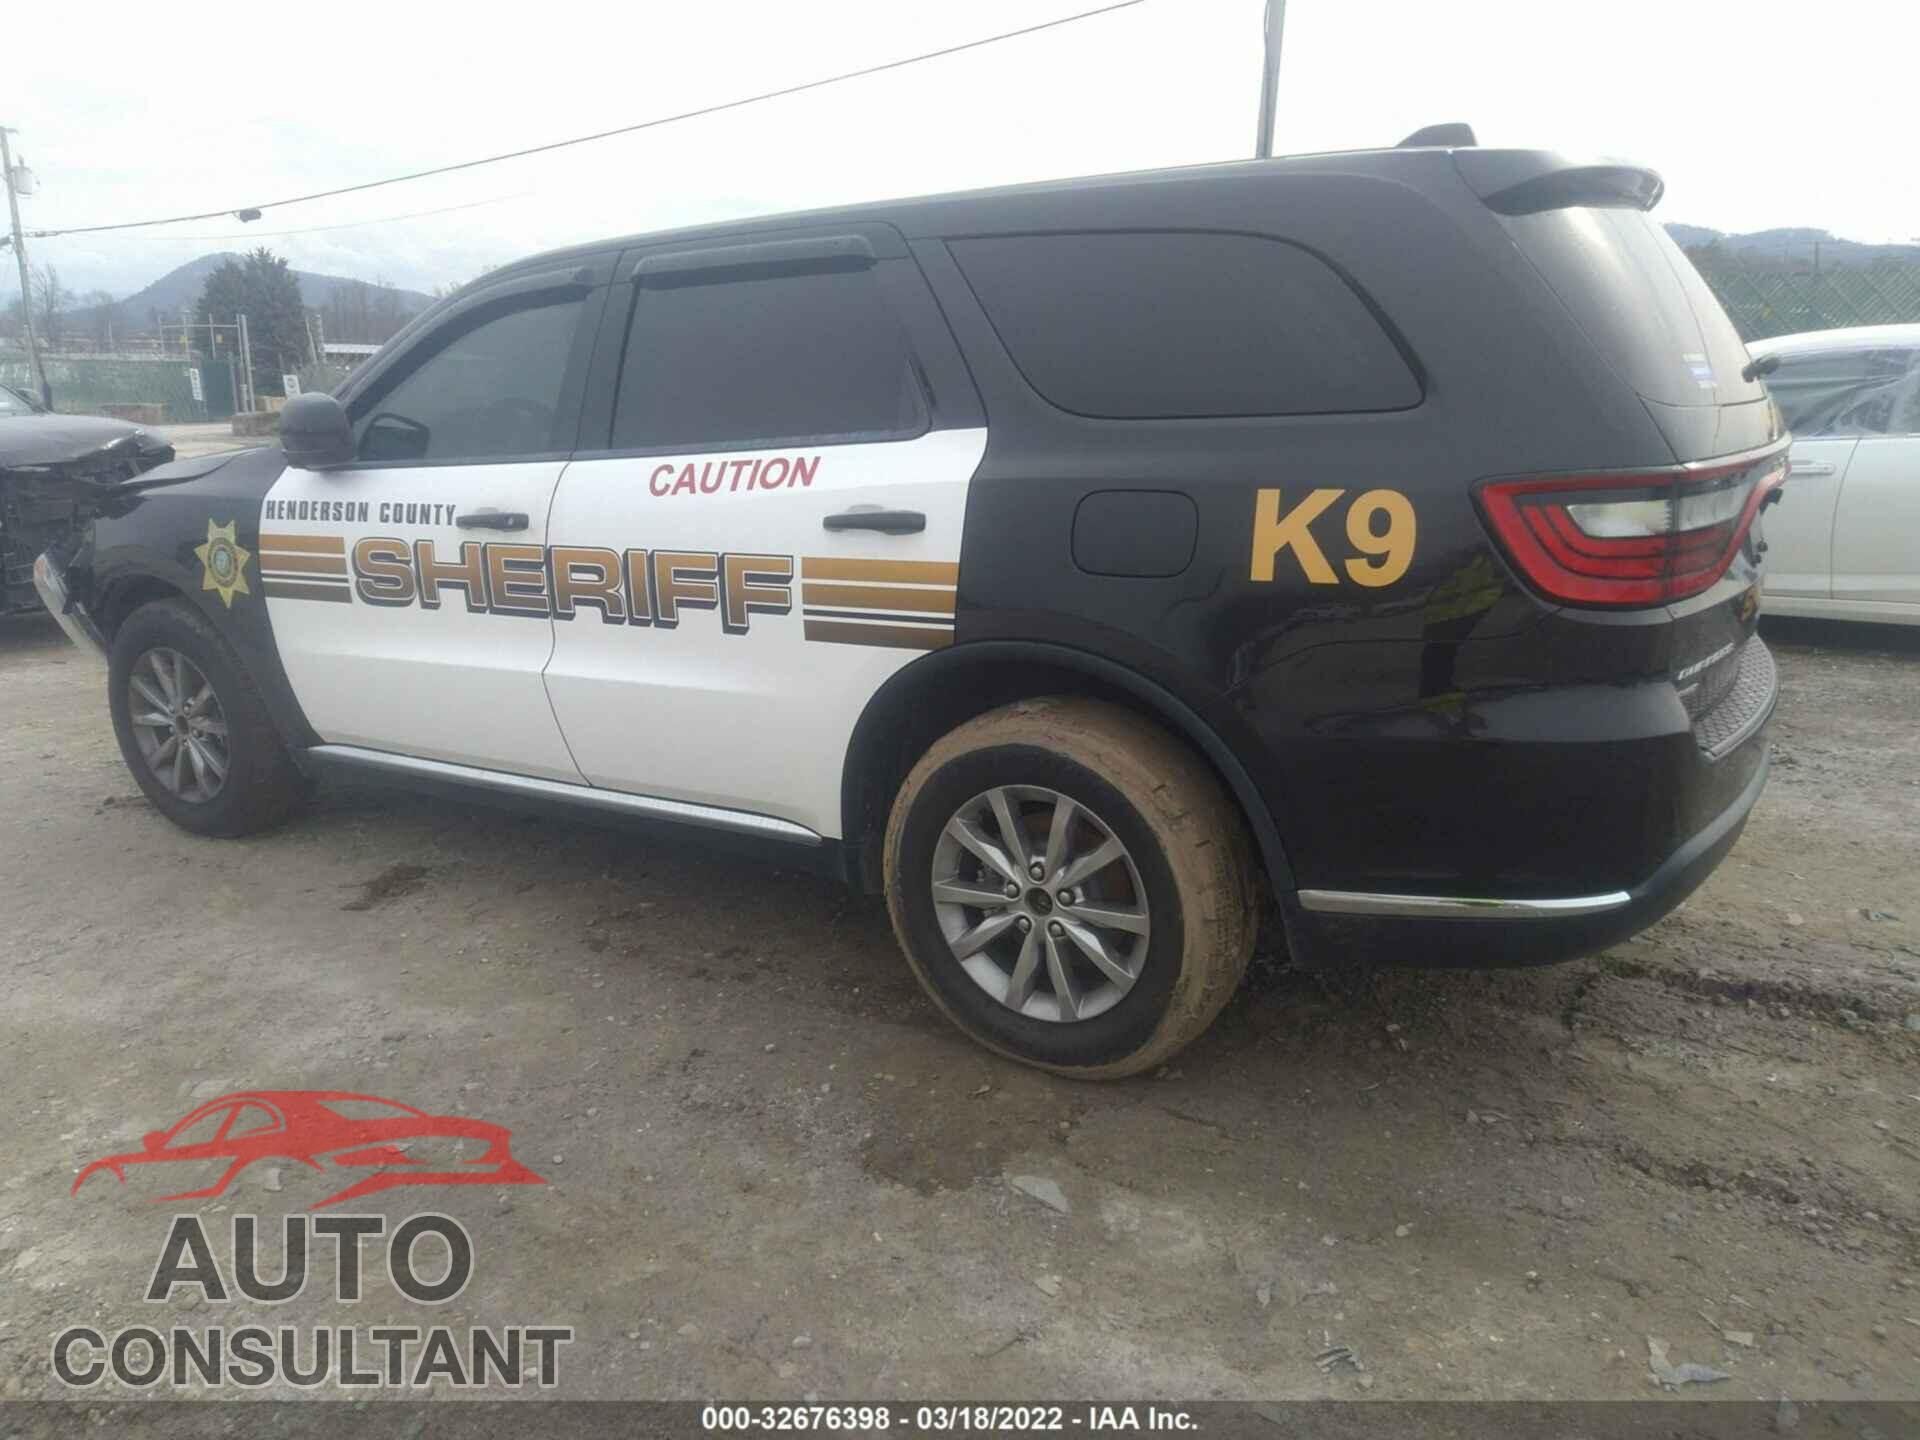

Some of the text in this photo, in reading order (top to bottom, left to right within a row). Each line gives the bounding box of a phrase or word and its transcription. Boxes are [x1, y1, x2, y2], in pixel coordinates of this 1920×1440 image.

[649, 456, 821, 497] CAUTION
[265, 500, 457, 526] HENDERSON COUNTY
[1250, 488, 1417, 587] K9
[351, 537, 794, 635] SHERIFF
